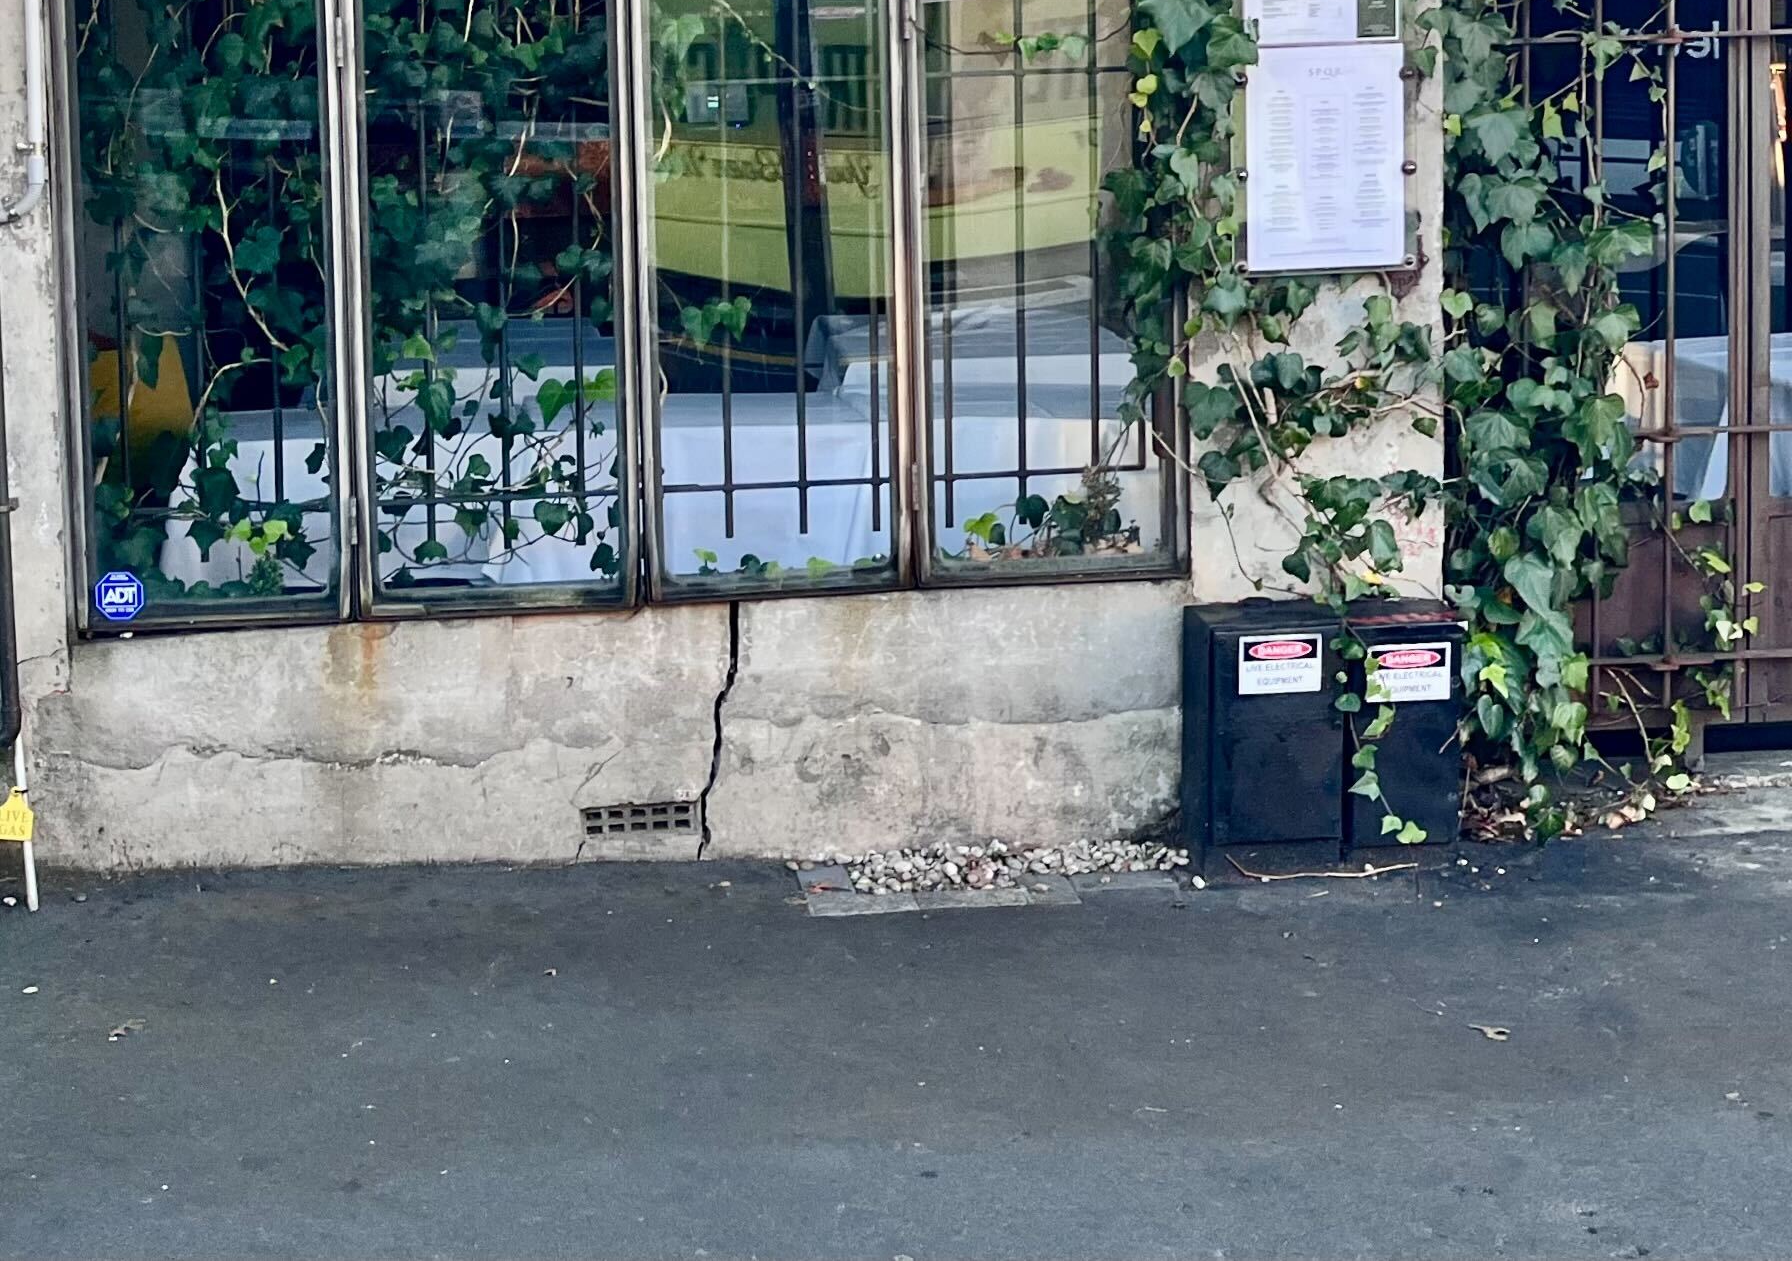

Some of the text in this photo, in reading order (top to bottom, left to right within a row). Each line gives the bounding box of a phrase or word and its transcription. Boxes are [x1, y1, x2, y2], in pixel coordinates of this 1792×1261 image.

[103, 586, 137, 604] ADT
[1265, 662, 1313, 672] ELECTRICAL
[1257, 675, 1303, 686] EQUIPMENT
[1391, 684, 1431, 694] QUIPMENT
